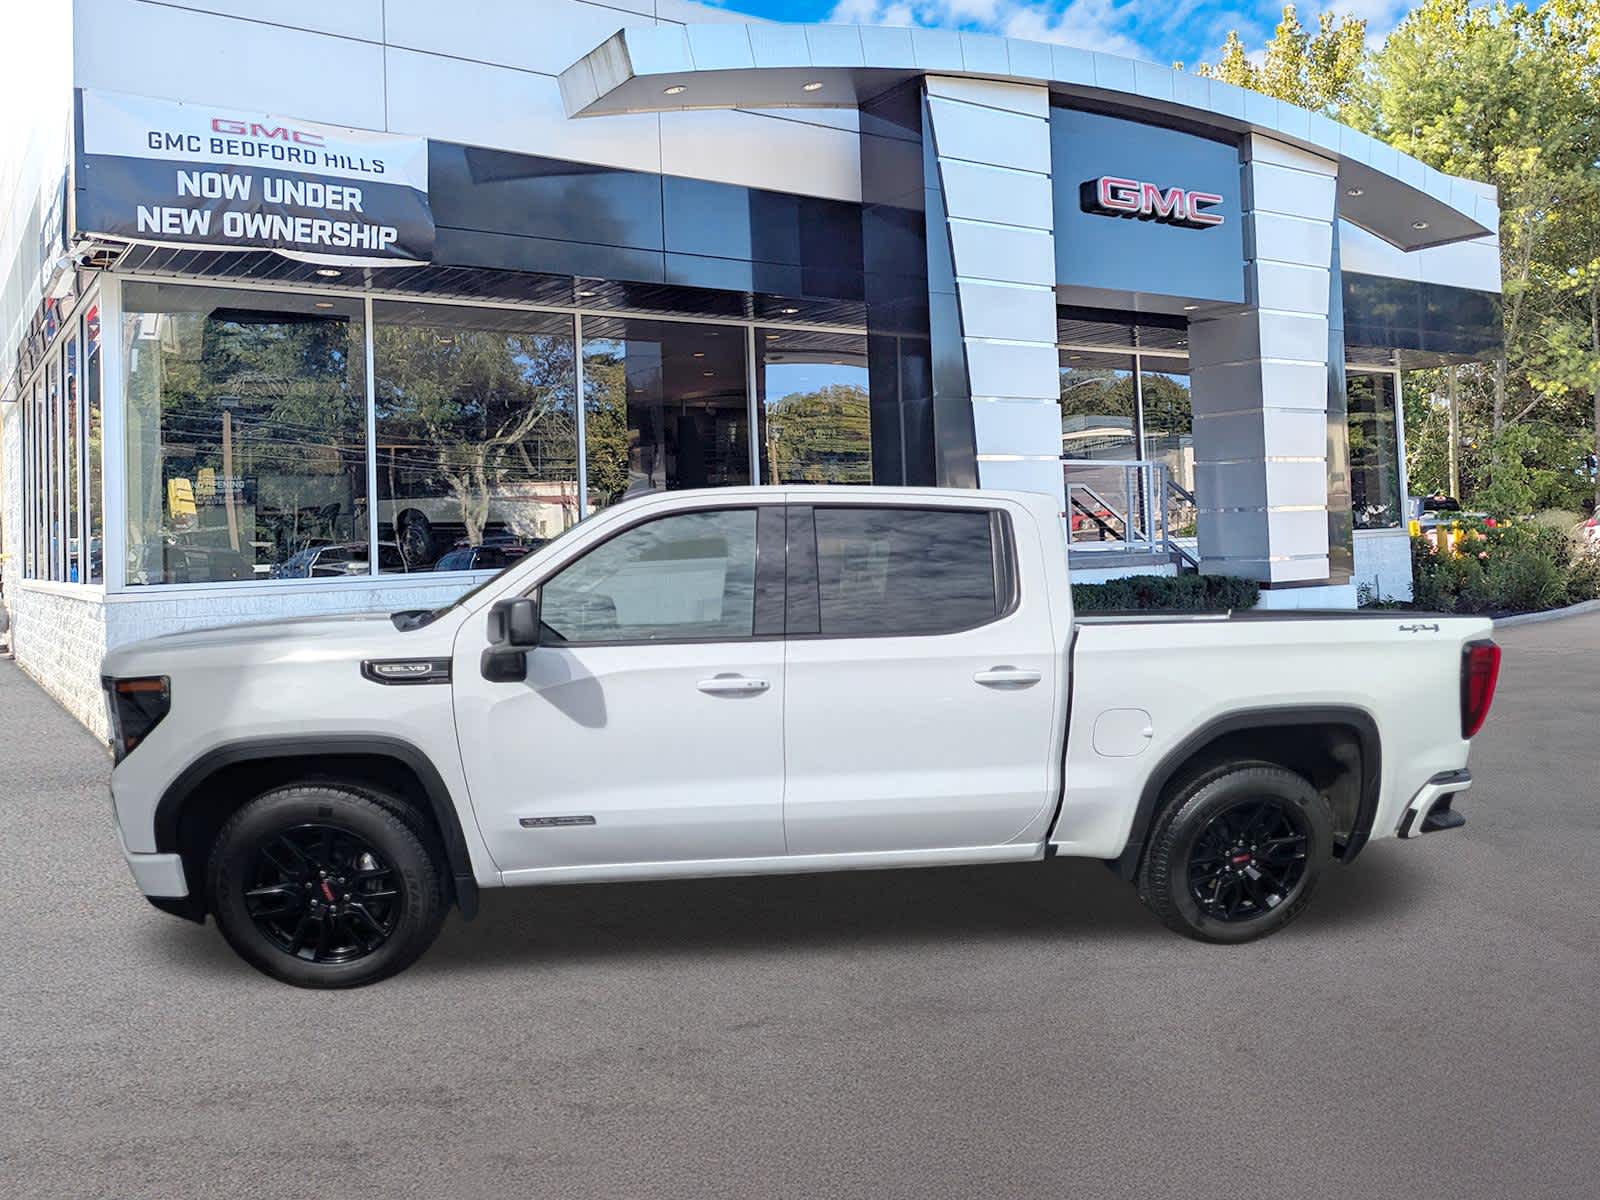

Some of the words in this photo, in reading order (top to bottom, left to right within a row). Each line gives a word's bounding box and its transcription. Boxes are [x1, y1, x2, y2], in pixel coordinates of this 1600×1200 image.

[148, 131, 200, 152] GMC
[210, 138, 317, 165] BEDFORD
[325, 154, 385, 174] HILLS
[211, 118, 325, 147] GMC
[177, 170, 252, 201] NOW
[264, 176, 363, 212] UNDER
[1097, 175, 1225, 225] GMC
[136, 205, 212, 236] NEW
[223, 211, 398, 250] OWNERSHIP
